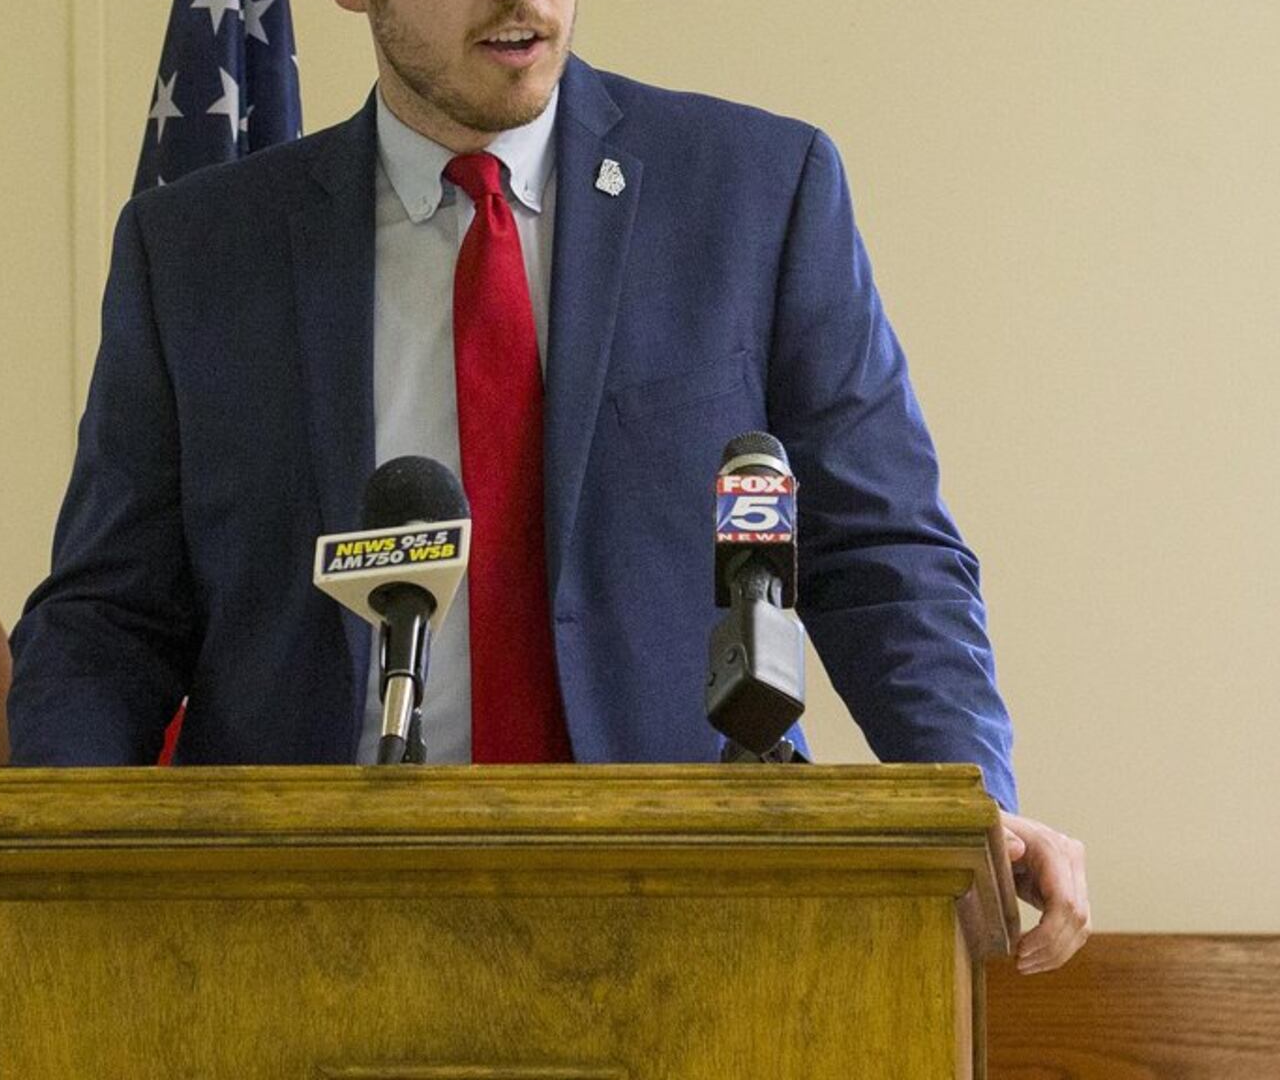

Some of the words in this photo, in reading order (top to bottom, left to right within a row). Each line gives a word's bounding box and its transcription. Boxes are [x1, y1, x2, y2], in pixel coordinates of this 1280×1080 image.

[722, 475, 788, 494] FOX
[730, 496, 780, 532] 5
[335, 537, 396, 557] NEWS
[400, 531, 448, 550] 95.5
[717, 532, 793, 542] NEWS
[328, 555, 363, 571] AM
[364, 550, 405, 567] 750
[408, 543, 456, 562] WSB
